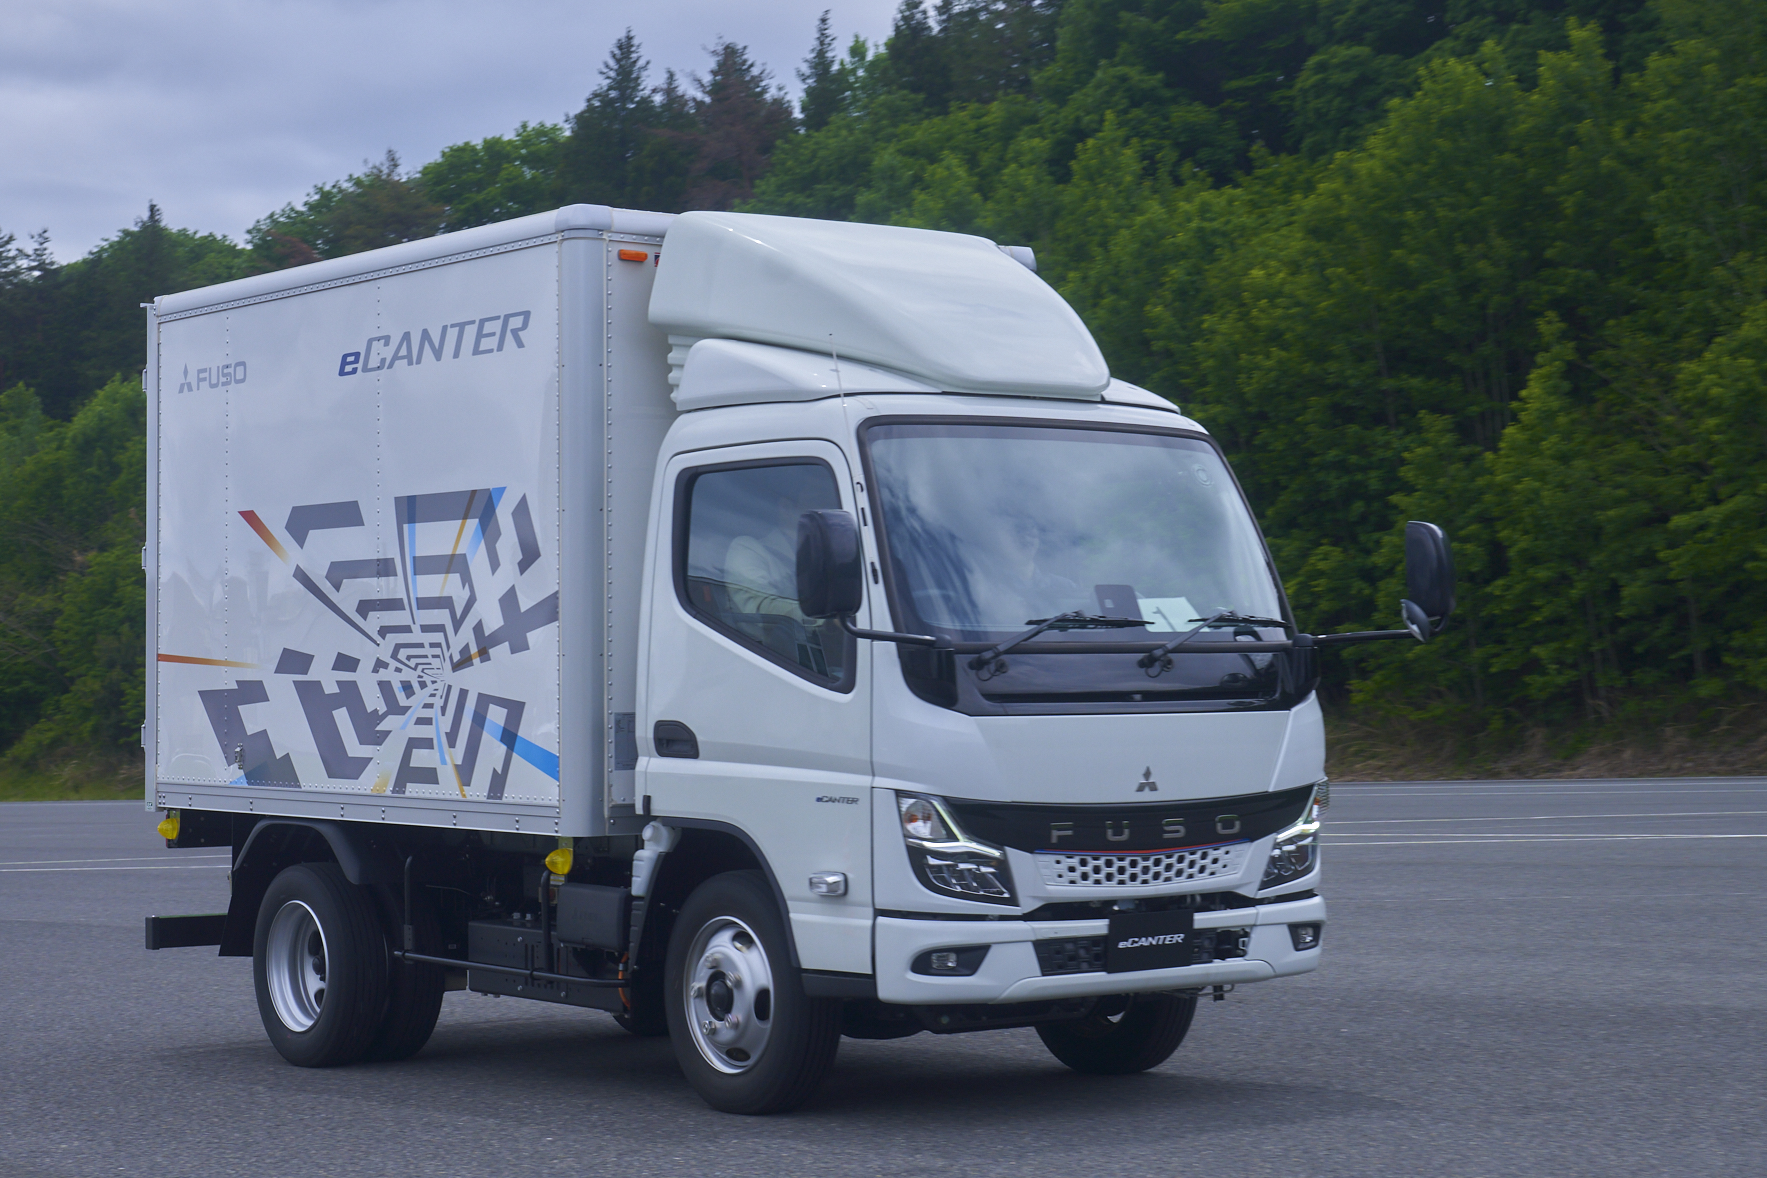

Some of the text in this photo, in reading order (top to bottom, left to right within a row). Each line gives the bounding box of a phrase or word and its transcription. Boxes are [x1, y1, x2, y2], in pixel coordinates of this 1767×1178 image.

[338, 310, 531, 377] eCANTER
[196, 361, 247, 391] FUSO
[1050, 814, 1241, 843] FUSO
[1117, 933, 1185, 949] eCANTER
